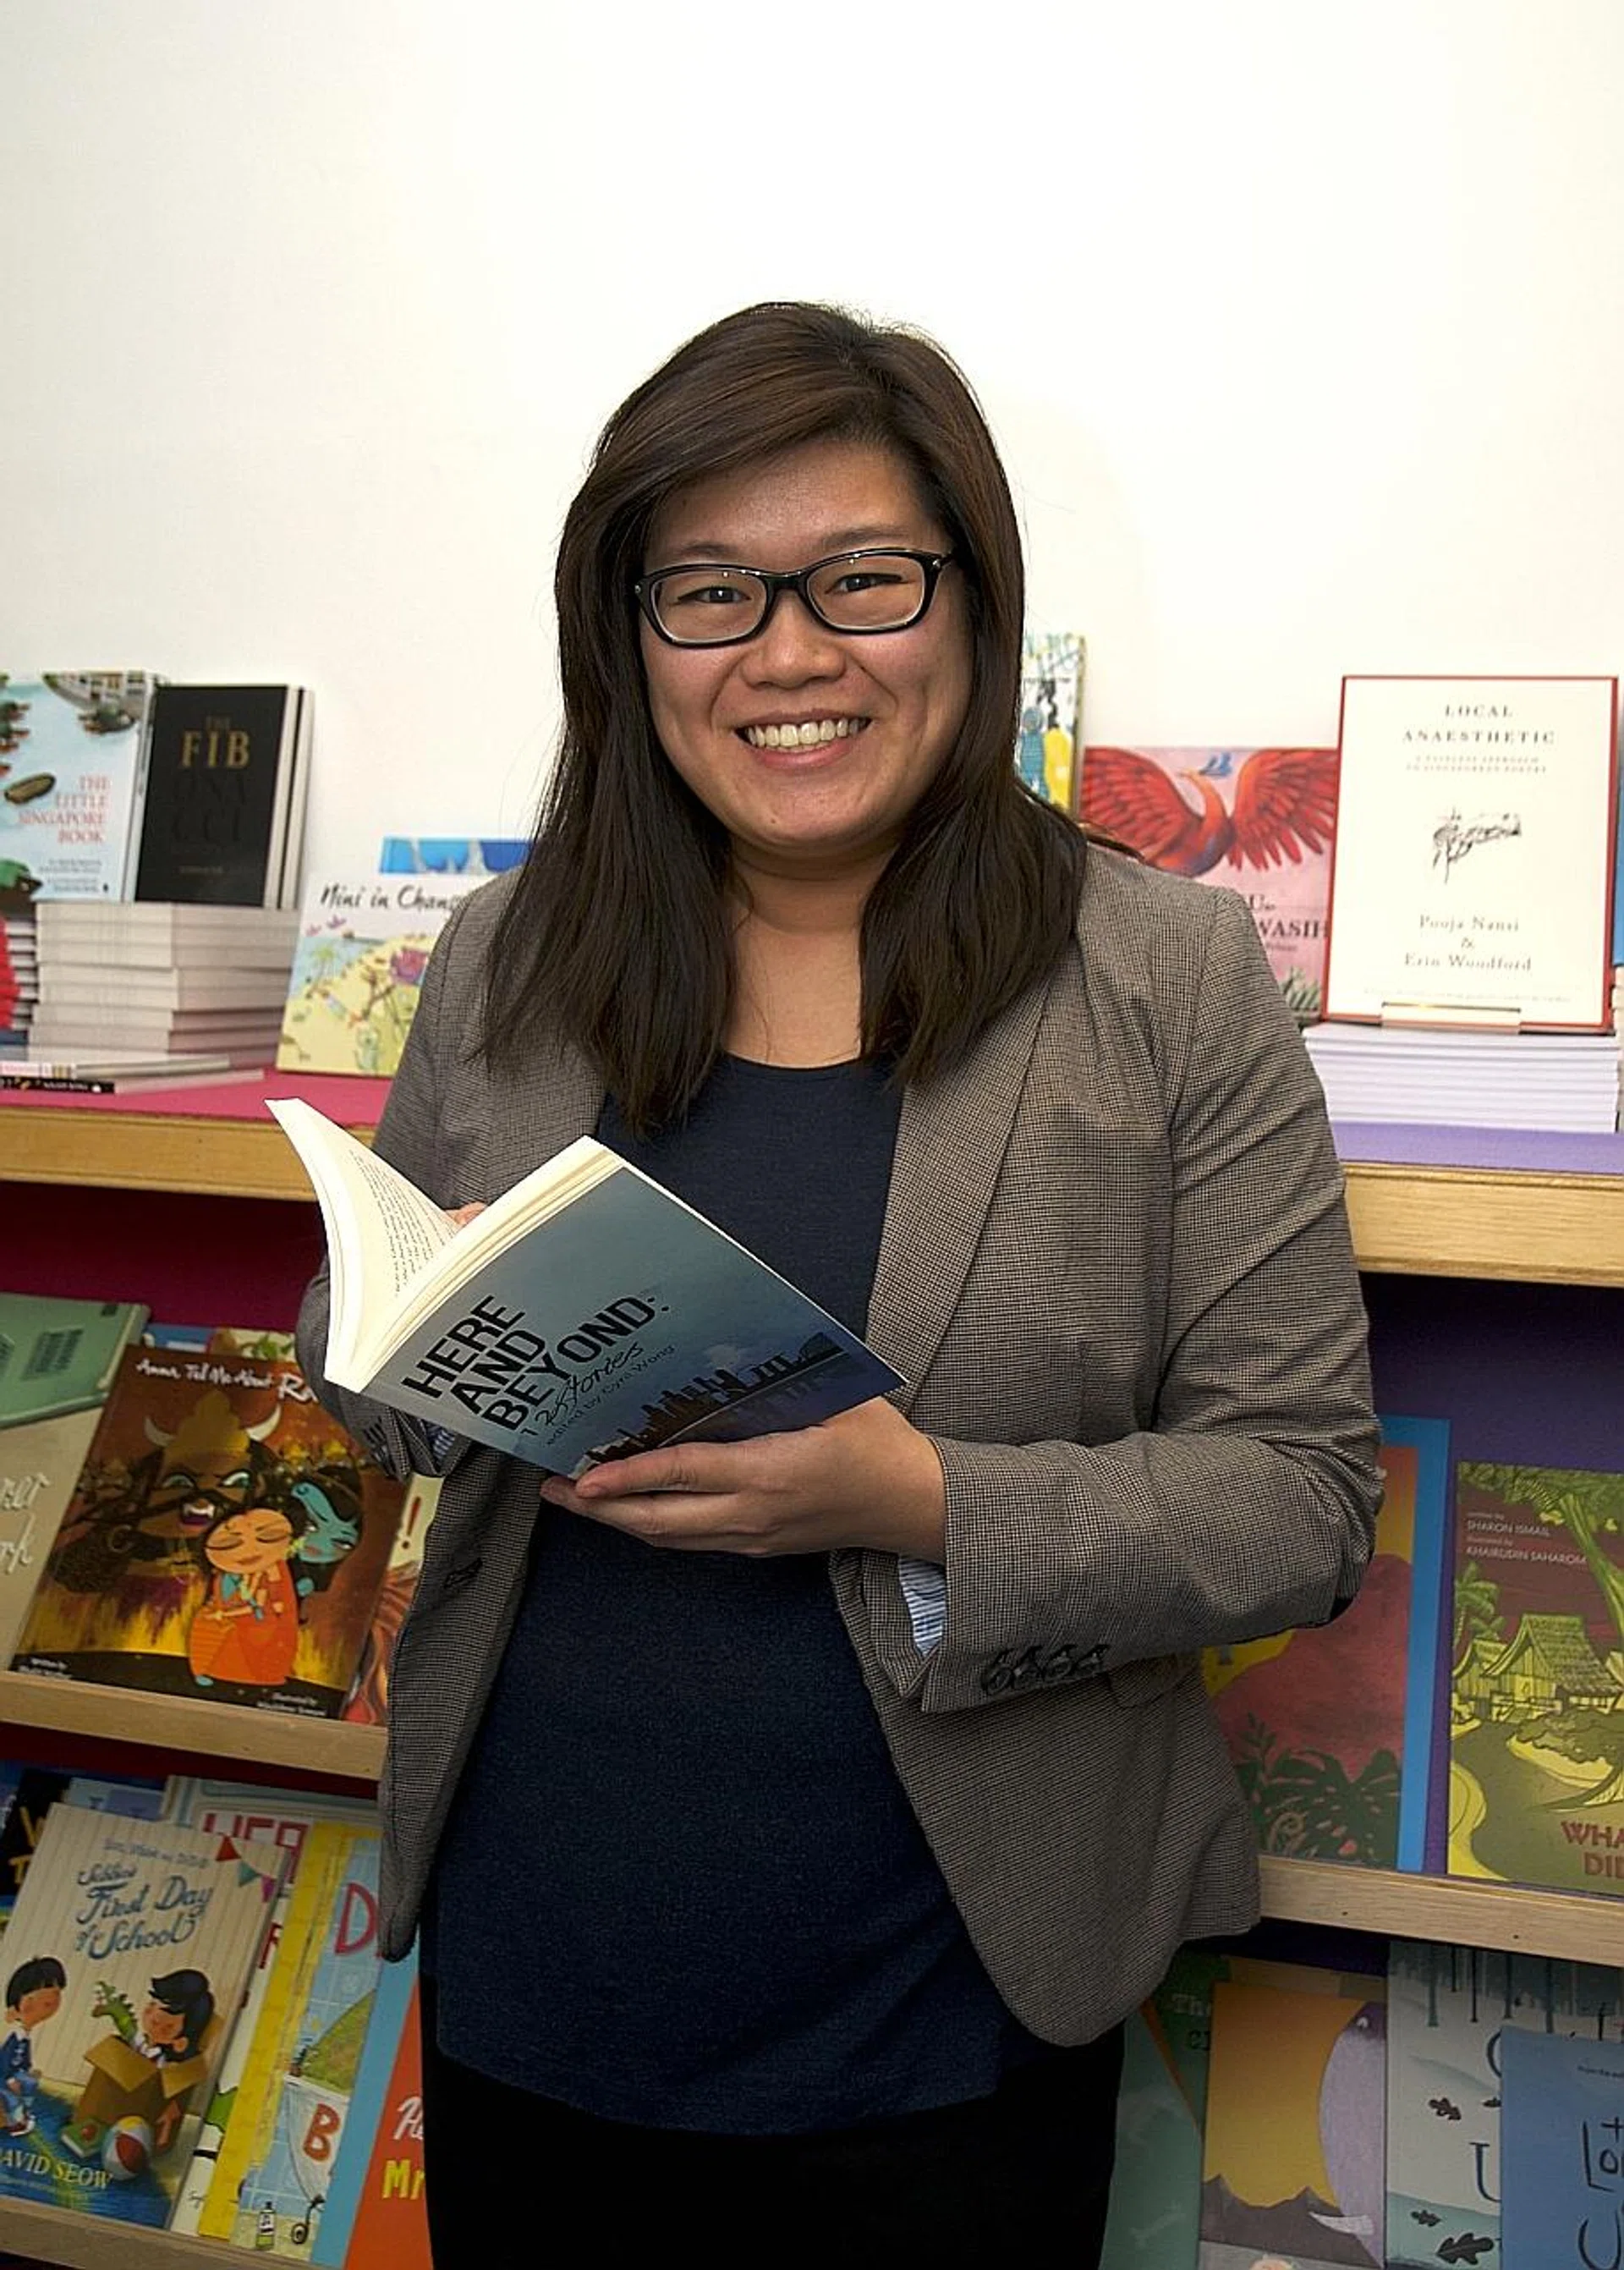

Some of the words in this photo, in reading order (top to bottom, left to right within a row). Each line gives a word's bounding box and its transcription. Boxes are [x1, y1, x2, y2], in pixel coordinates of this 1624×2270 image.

[1445, 705, 1513, 718] LOCAL
[1402, 730, 1555, 745] ANAESTHETIC
[19, 810, 107, 826] SINGAPORE
[58, 828, 103, 844] BOOK
[321, 883, 361, 909] Mini
[370, 886, 390, 909] in
[398, 884, 454, 913] Chan
[401, 1294, 525, 1399] HERE
[450, 1329, 546, 1415] AND
[481, 1295, 670, 1431] BEYOND:
[154, 1874, 214, 1917] Day
[89, 1911, 196, 1959] School
[52, 2160, 115, 2190] SEOW
